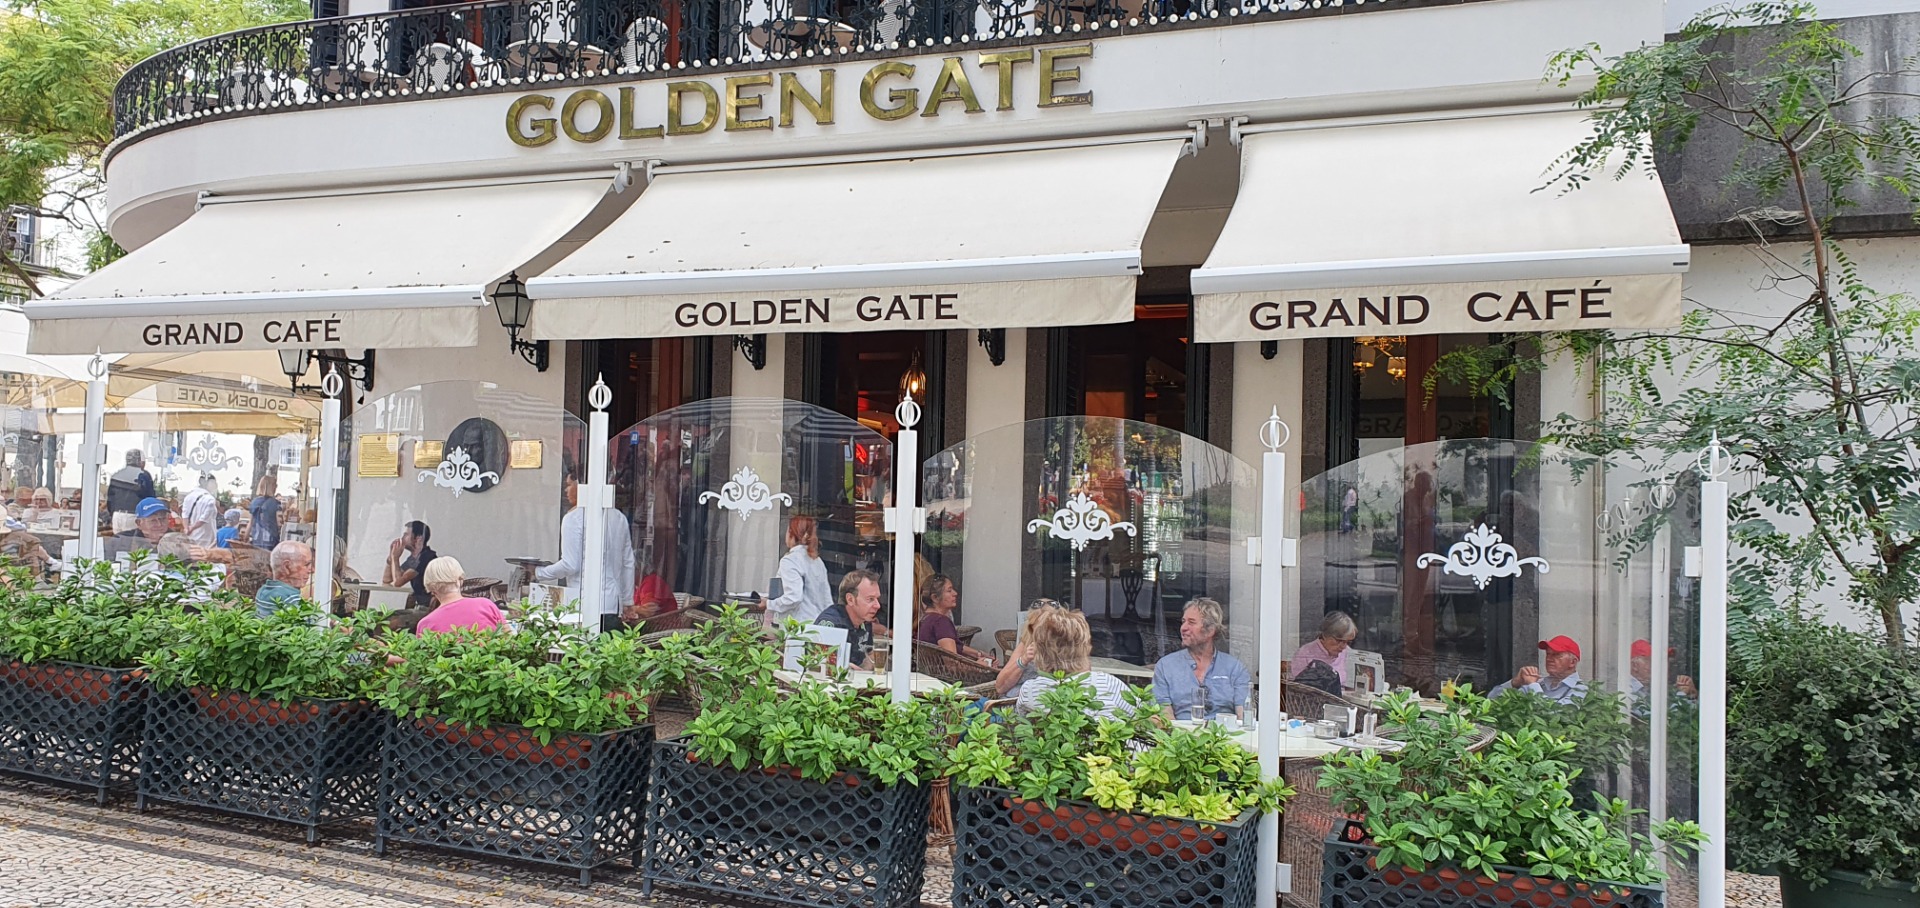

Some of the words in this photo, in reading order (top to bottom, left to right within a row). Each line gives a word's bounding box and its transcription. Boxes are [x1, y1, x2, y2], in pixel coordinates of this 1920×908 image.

[505, 68, 836, 148] GOLDEN
[859, 43, 1094, 121] GATE
[674, 298, 830, 327] GOLDEN
[856, 293, 959, 322] GATE
[1249, 295, 1430, 330] GRAND
[1467, 279, 1613, 322] CAFÉ
[142, 322, 244, 346] GRAND
[263, 313, 341, 343] CAFÉ
